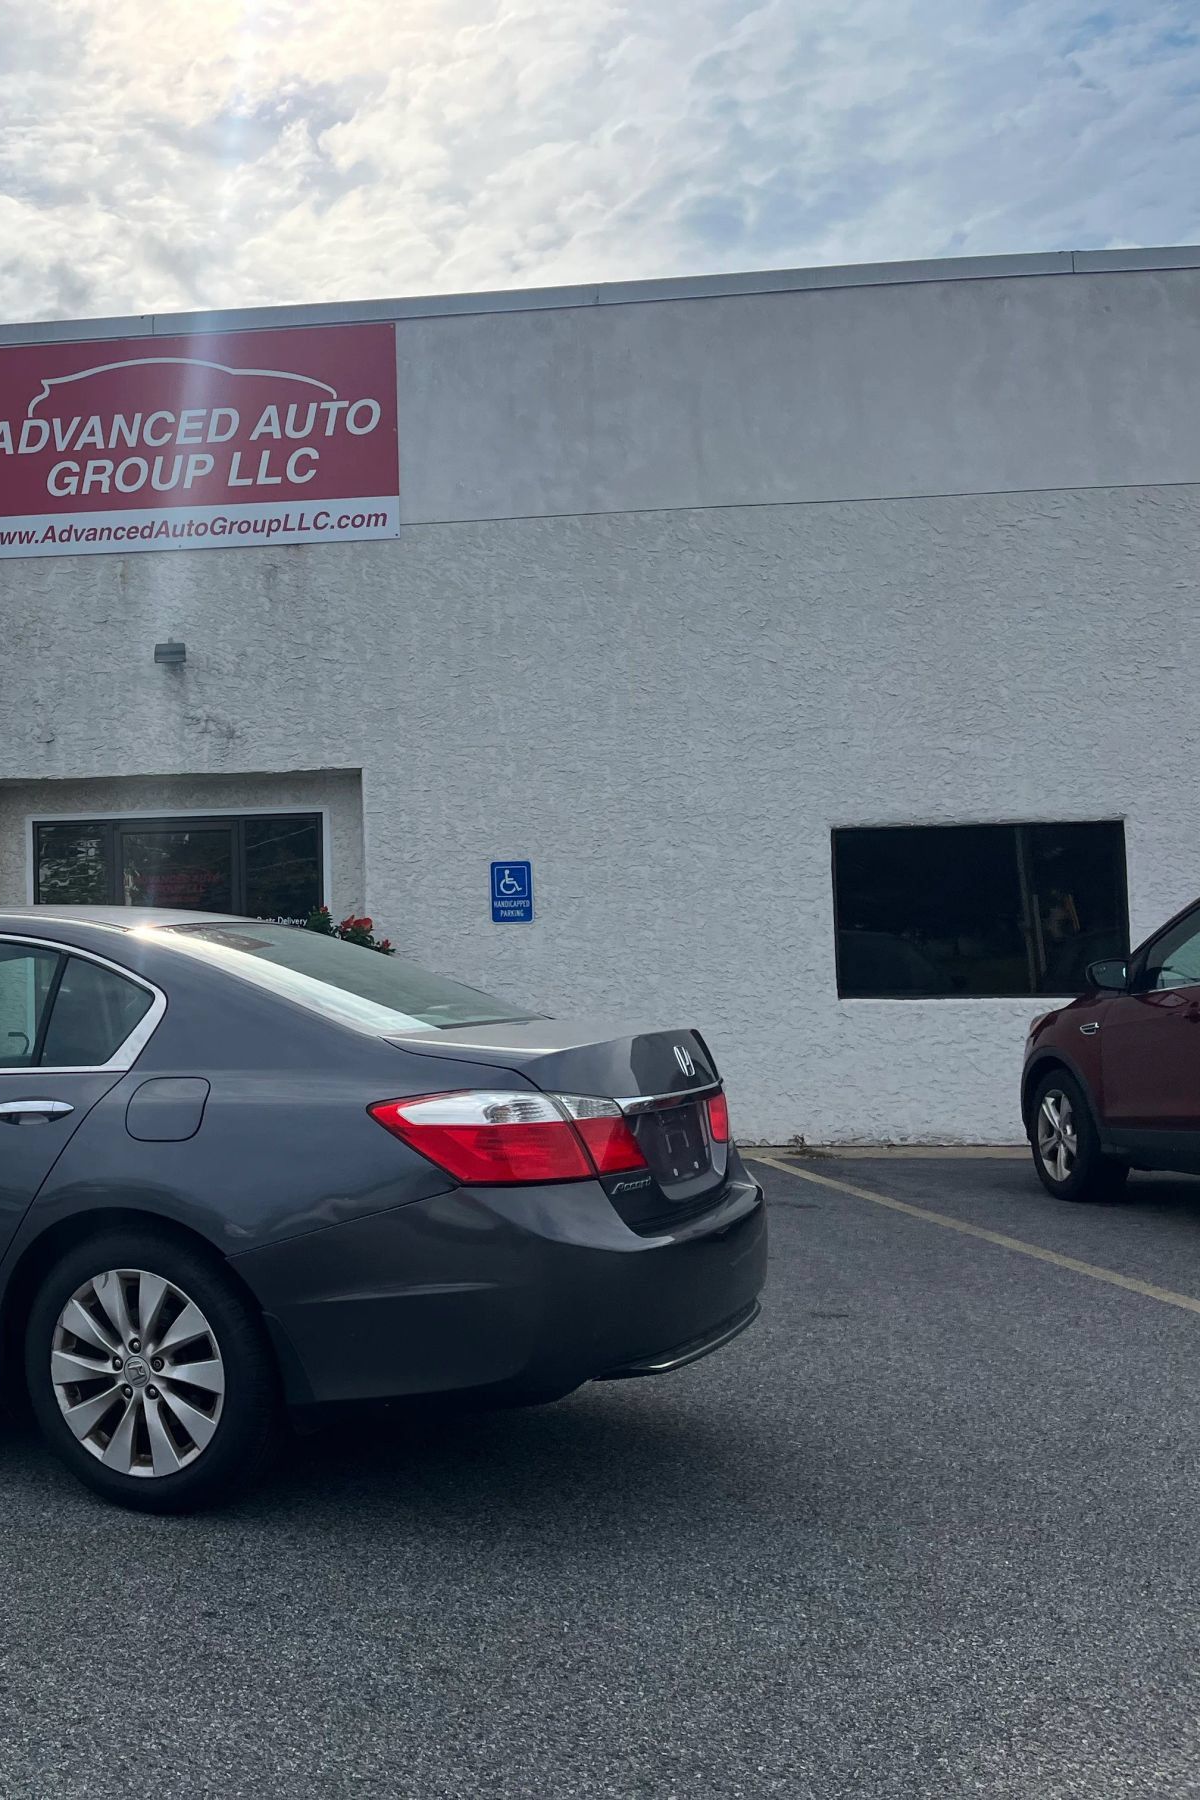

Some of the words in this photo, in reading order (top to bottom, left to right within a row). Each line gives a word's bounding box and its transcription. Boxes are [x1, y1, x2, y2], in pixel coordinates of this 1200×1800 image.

[249, 398, 381, 441] AUTO
[46, 453, 215, 497] GROUP
[227, 447, 320, 487] LLC
[493, 900, 531, 908] HANDICAPPED
[500, 909, 524, 917] PARKING
[277, 916, 308, 926] Delivery
